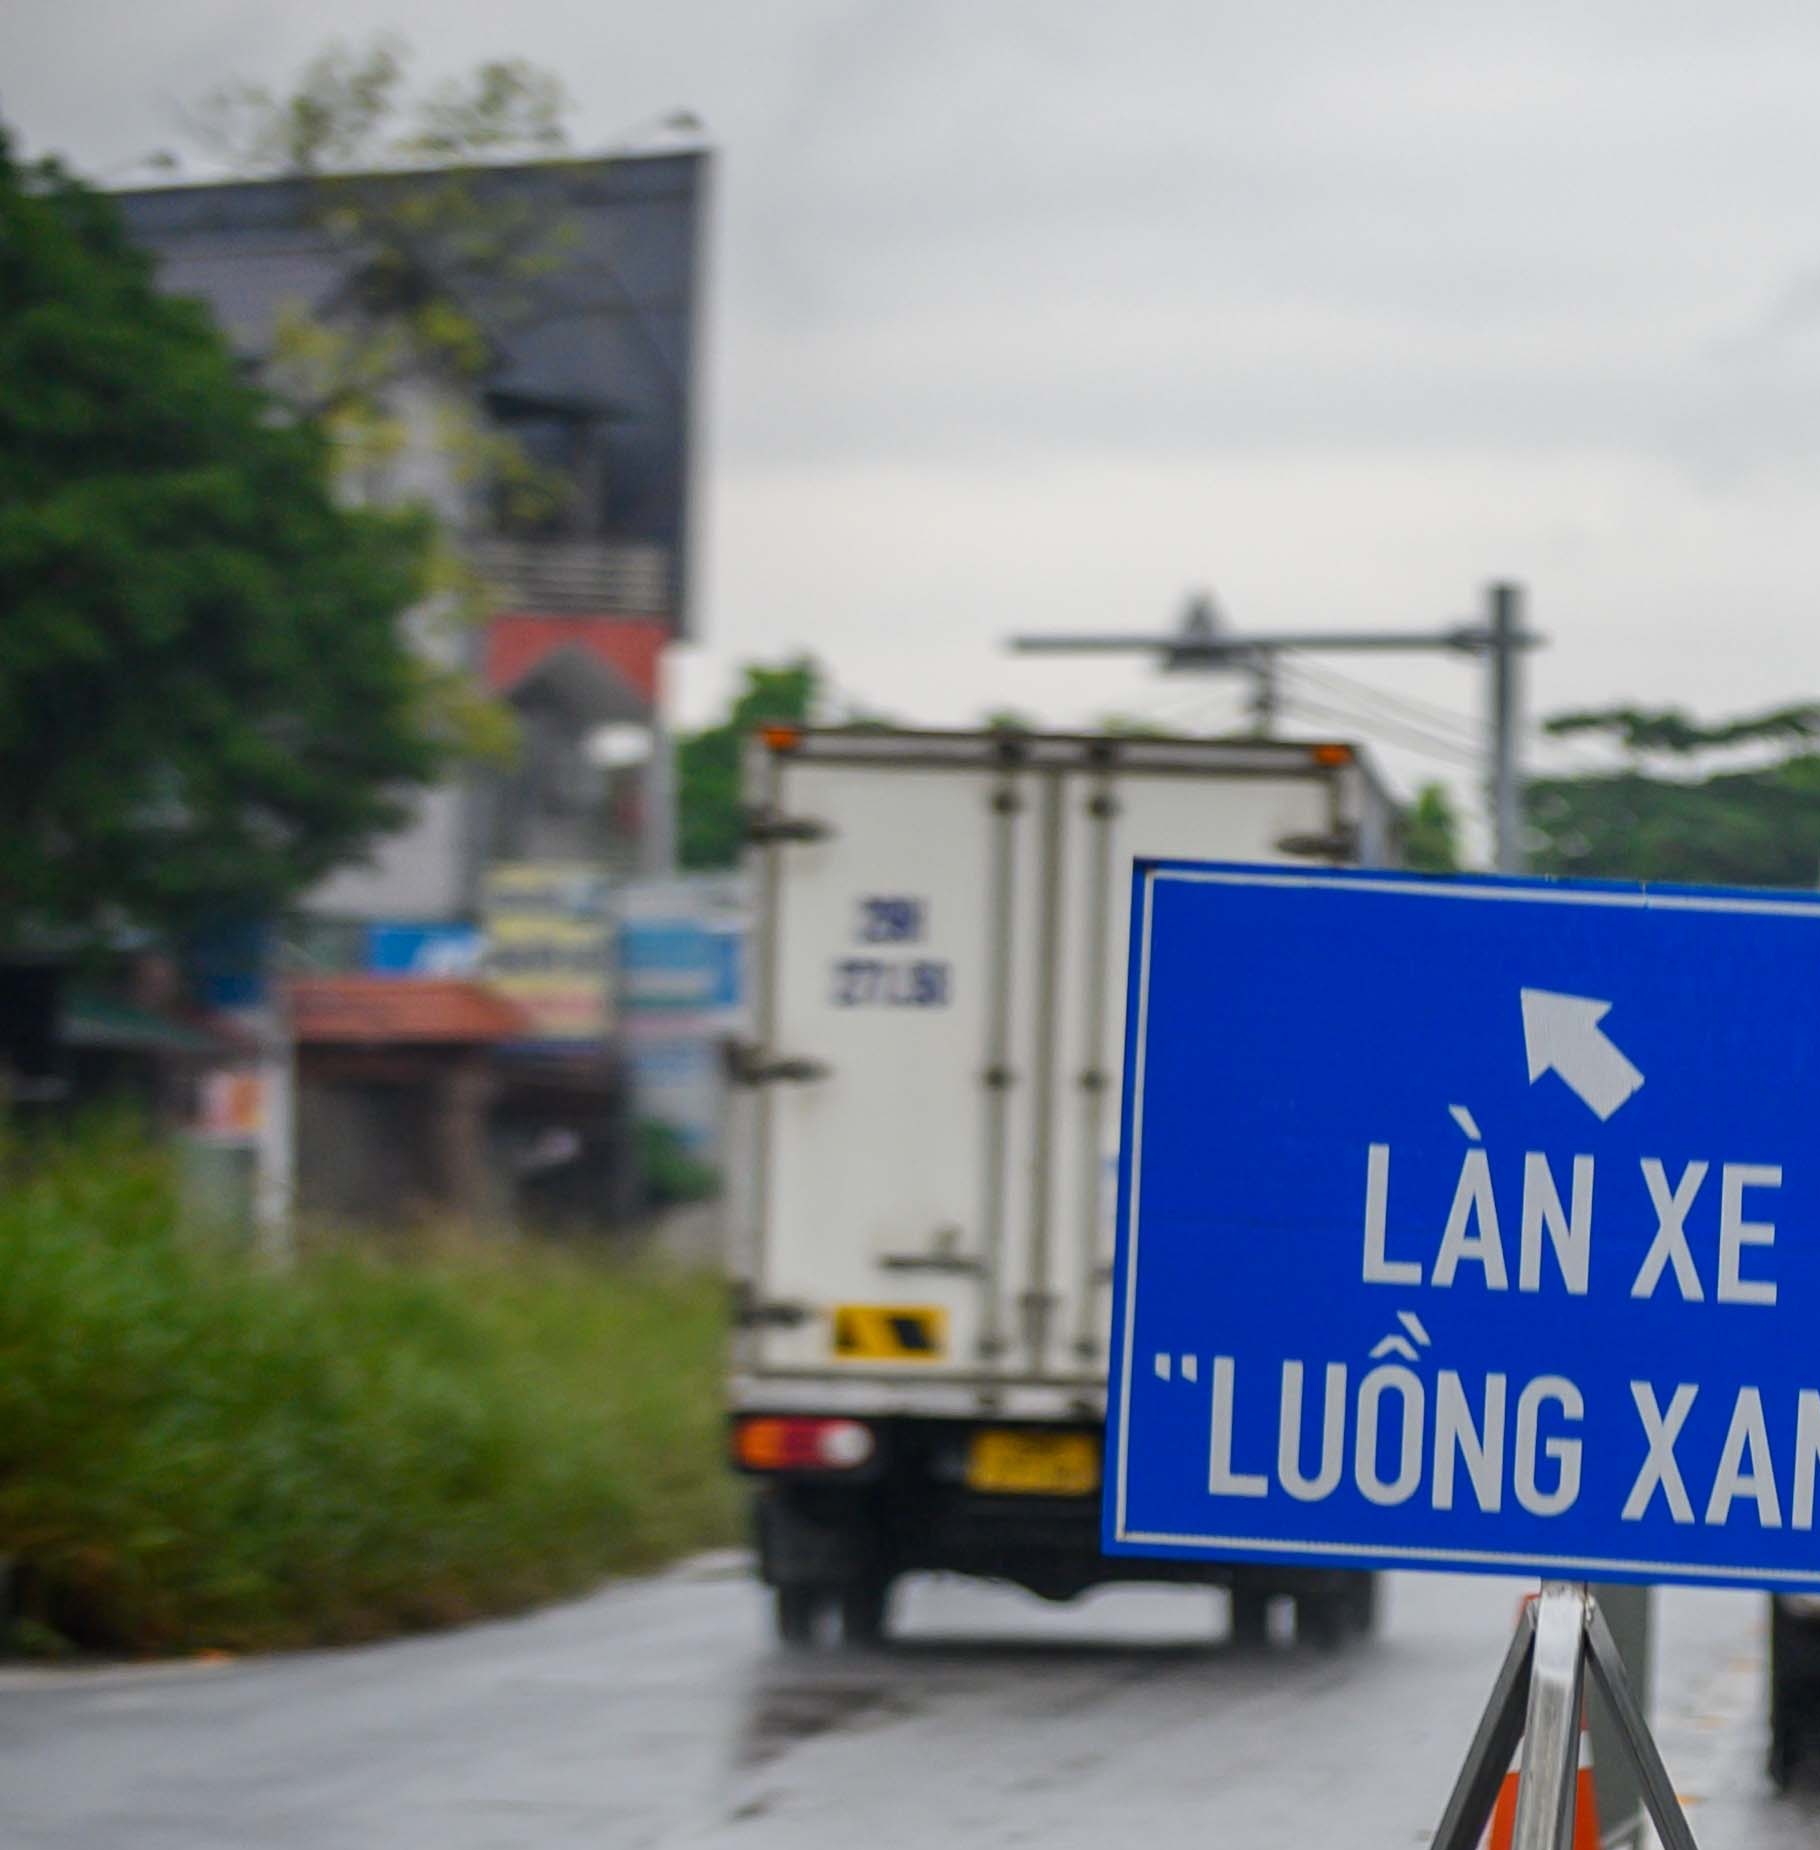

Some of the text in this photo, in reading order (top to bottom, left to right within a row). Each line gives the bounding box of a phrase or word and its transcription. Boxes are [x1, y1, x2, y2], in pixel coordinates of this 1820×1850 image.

[1362, 1103, 1784, 1305] LÀN XE
[1154, 1311, 1585, 1516] "LUỒNG
